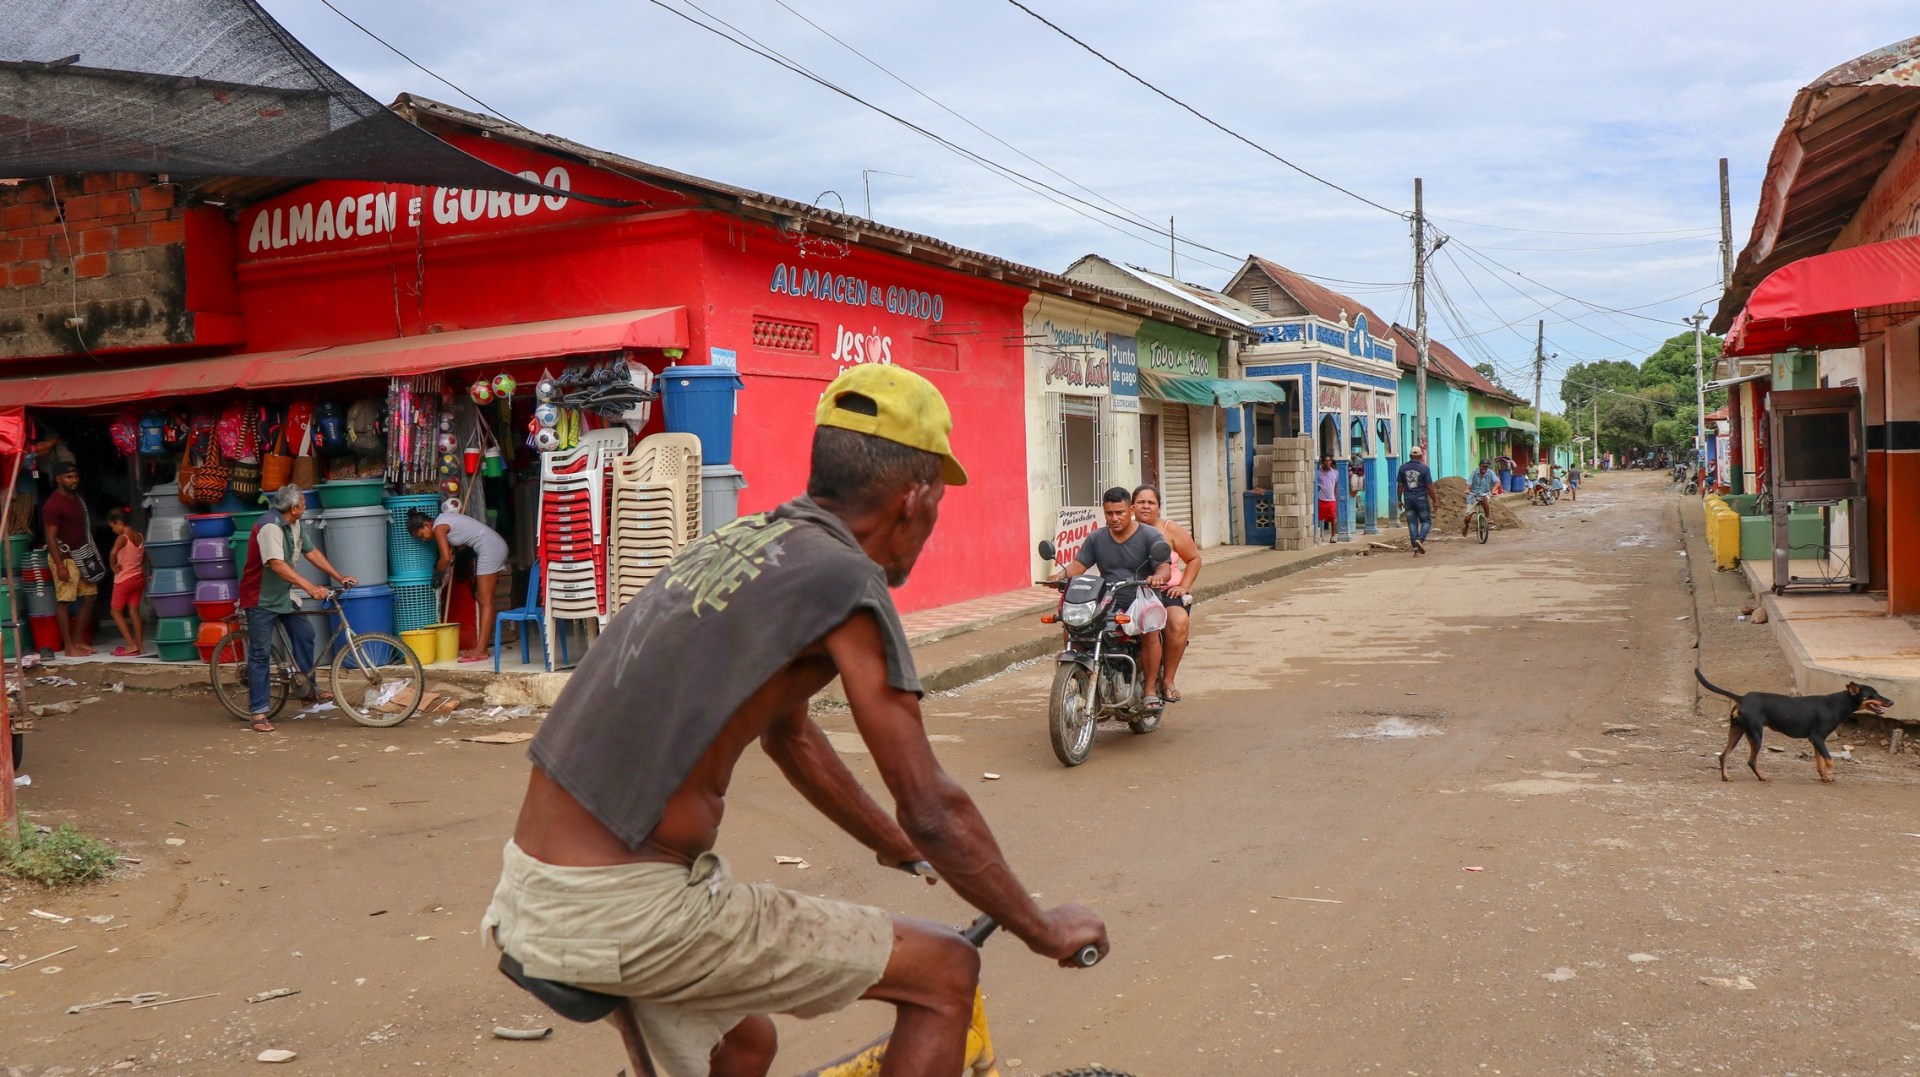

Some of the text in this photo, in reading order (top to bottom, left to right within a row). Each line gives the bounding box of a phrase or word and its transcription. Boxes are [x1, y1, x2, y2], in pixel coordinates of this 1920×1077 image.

[249, 191, 397, 253] ALMACEN
[770, 262, 943, 322] ALMACEN EL GORDO
[1112, 345, 1136, 366] Punto
[1177, 350, 1182, 367] A
[1113, 368, 1136, 386] de pago
[1062, 514, 1096, 526] Variedades
[1056, 521, 1098, 548] PAULA
[1054, 545, 1081, 567] AND
